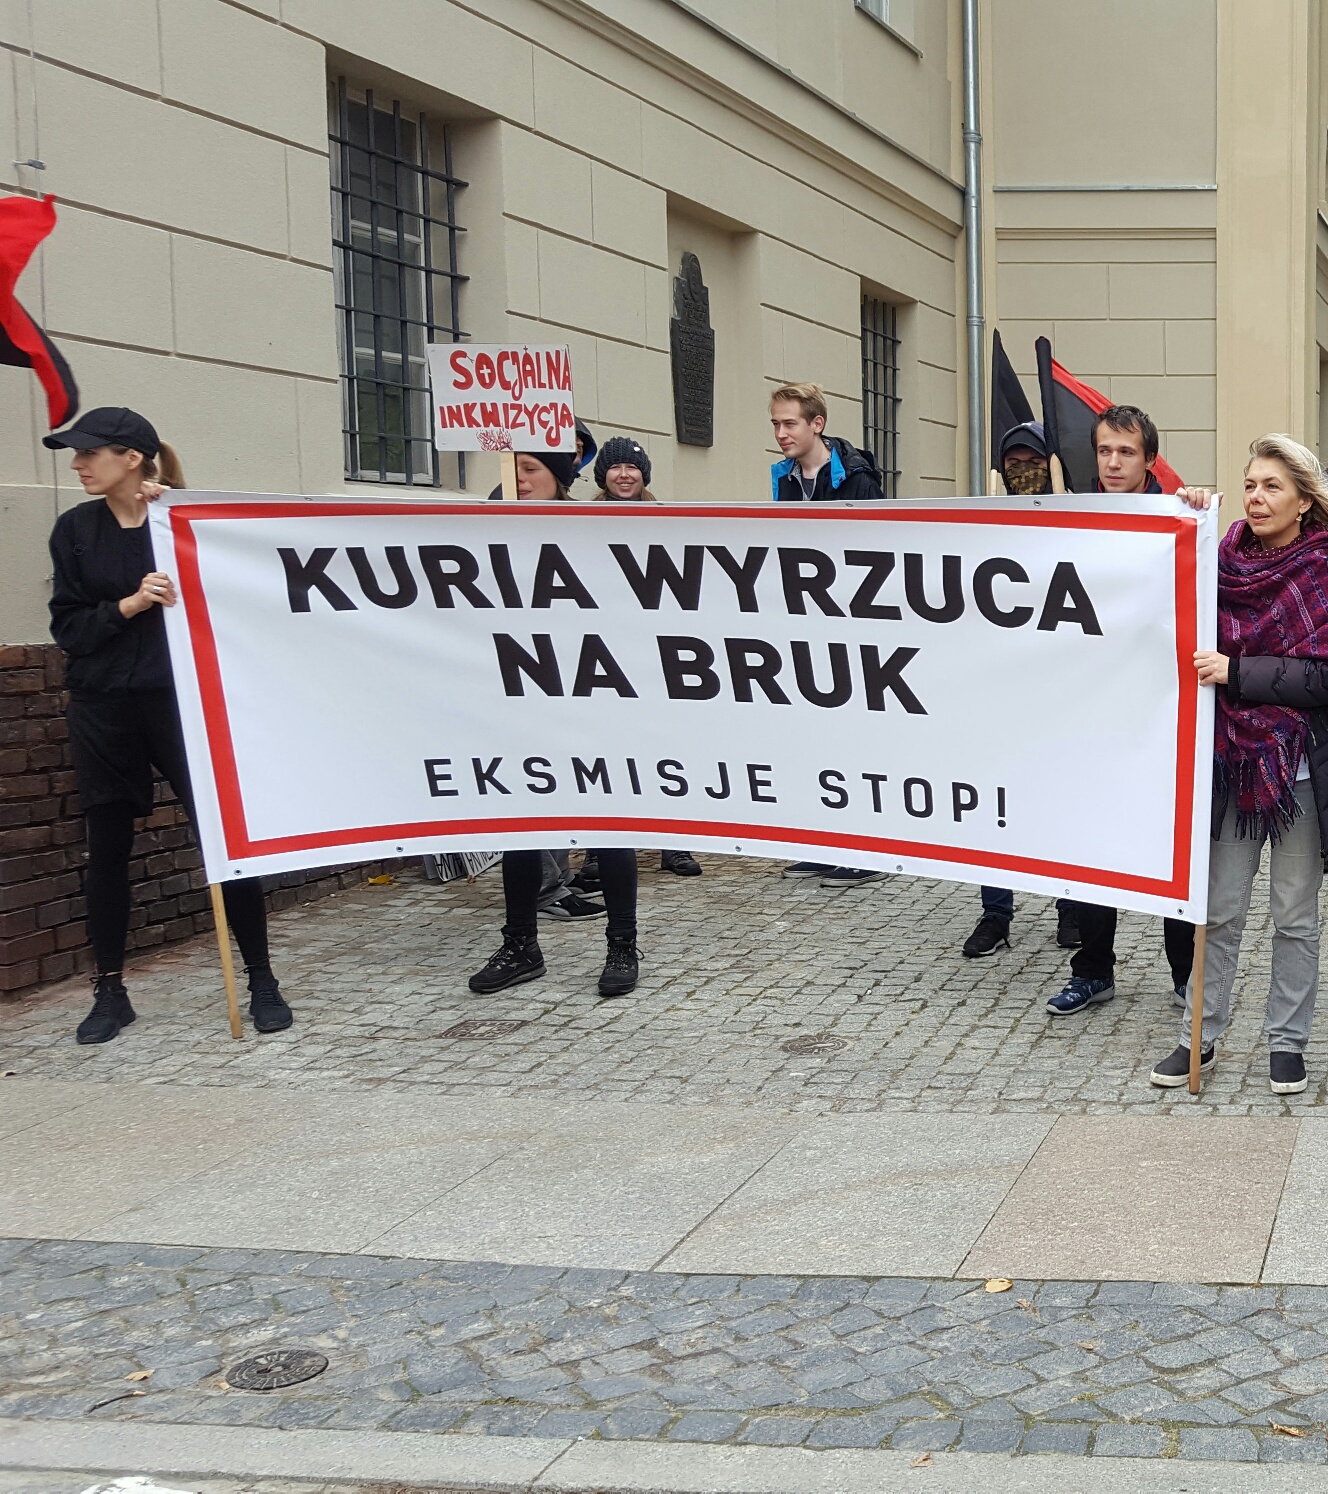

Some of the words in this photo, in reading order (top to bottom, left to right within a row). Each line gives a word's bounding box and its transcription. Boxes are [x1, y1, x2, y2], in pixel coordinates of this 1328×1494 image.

[449, 349, 573, 401] SOCJALNA
[439, 402, 575, 447] INKWIZYCJA
[277, 544, 598, 613] KURIA
[607, 544, 1104, 636] WYRZUCA
[493, 634, 639, 699] NA
[657, 636, 929, 716] BRUK
[424, 757, 777, 804] EKSMISJE
[818, 769, 1008, 829] STOP!
